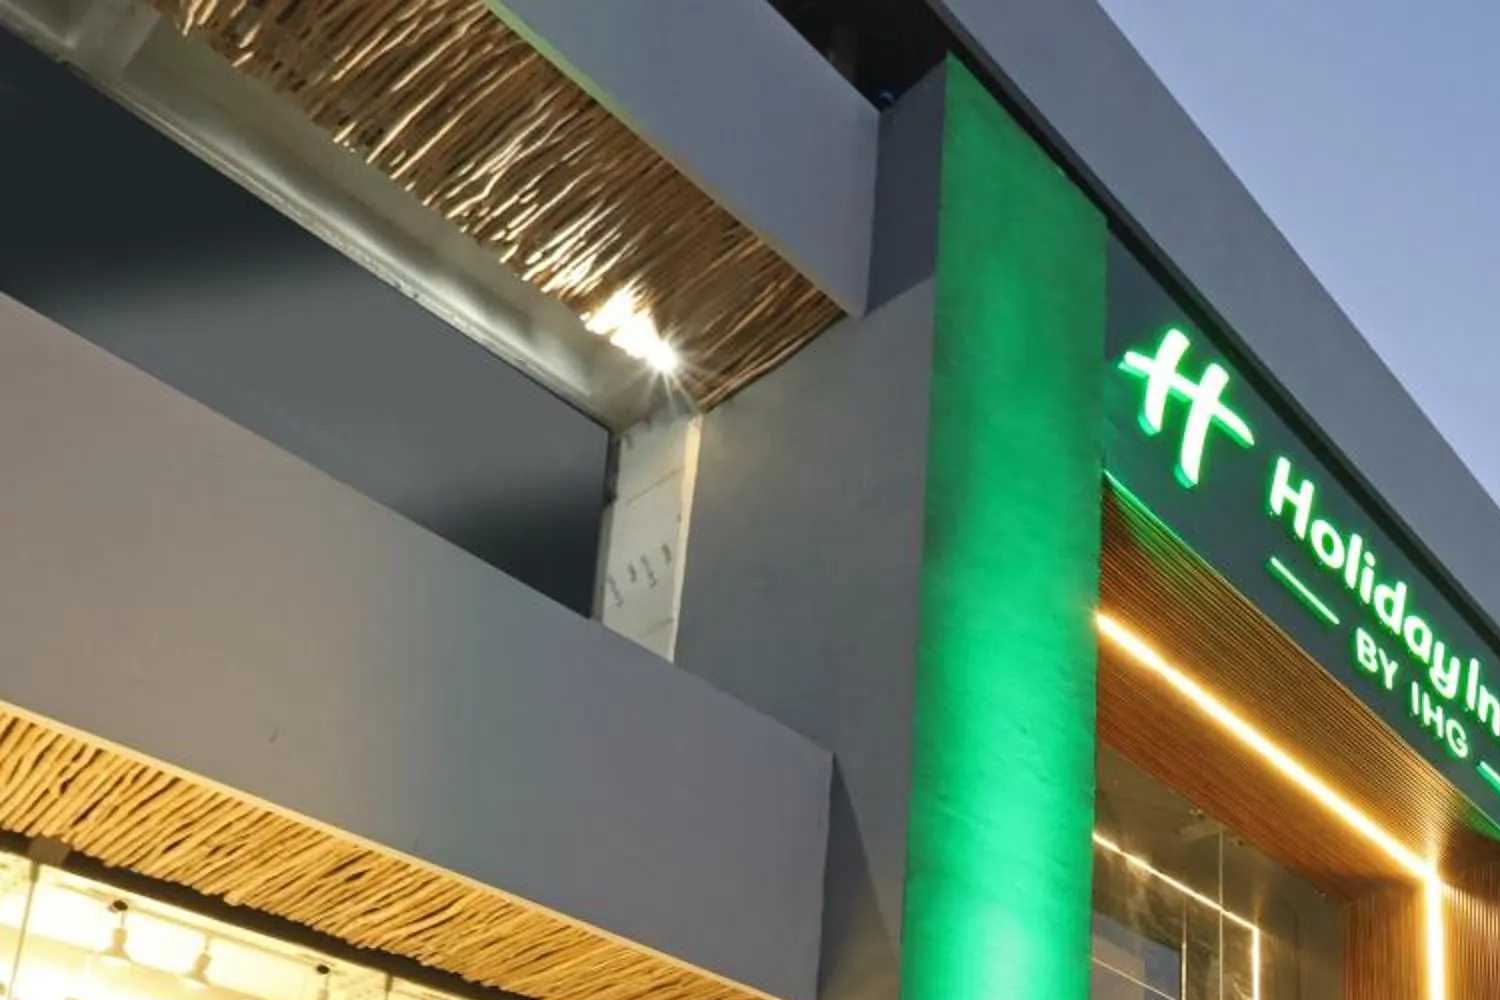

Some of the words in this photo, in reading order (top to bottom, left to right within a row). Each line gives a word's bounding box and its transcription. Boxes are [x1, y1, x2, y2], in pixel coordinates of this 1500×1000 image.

[1269, 455, 1460, 699] Holiday
[1355, 627, 1398, 690] BY
[1411, 681, 1468, 758] IHG
